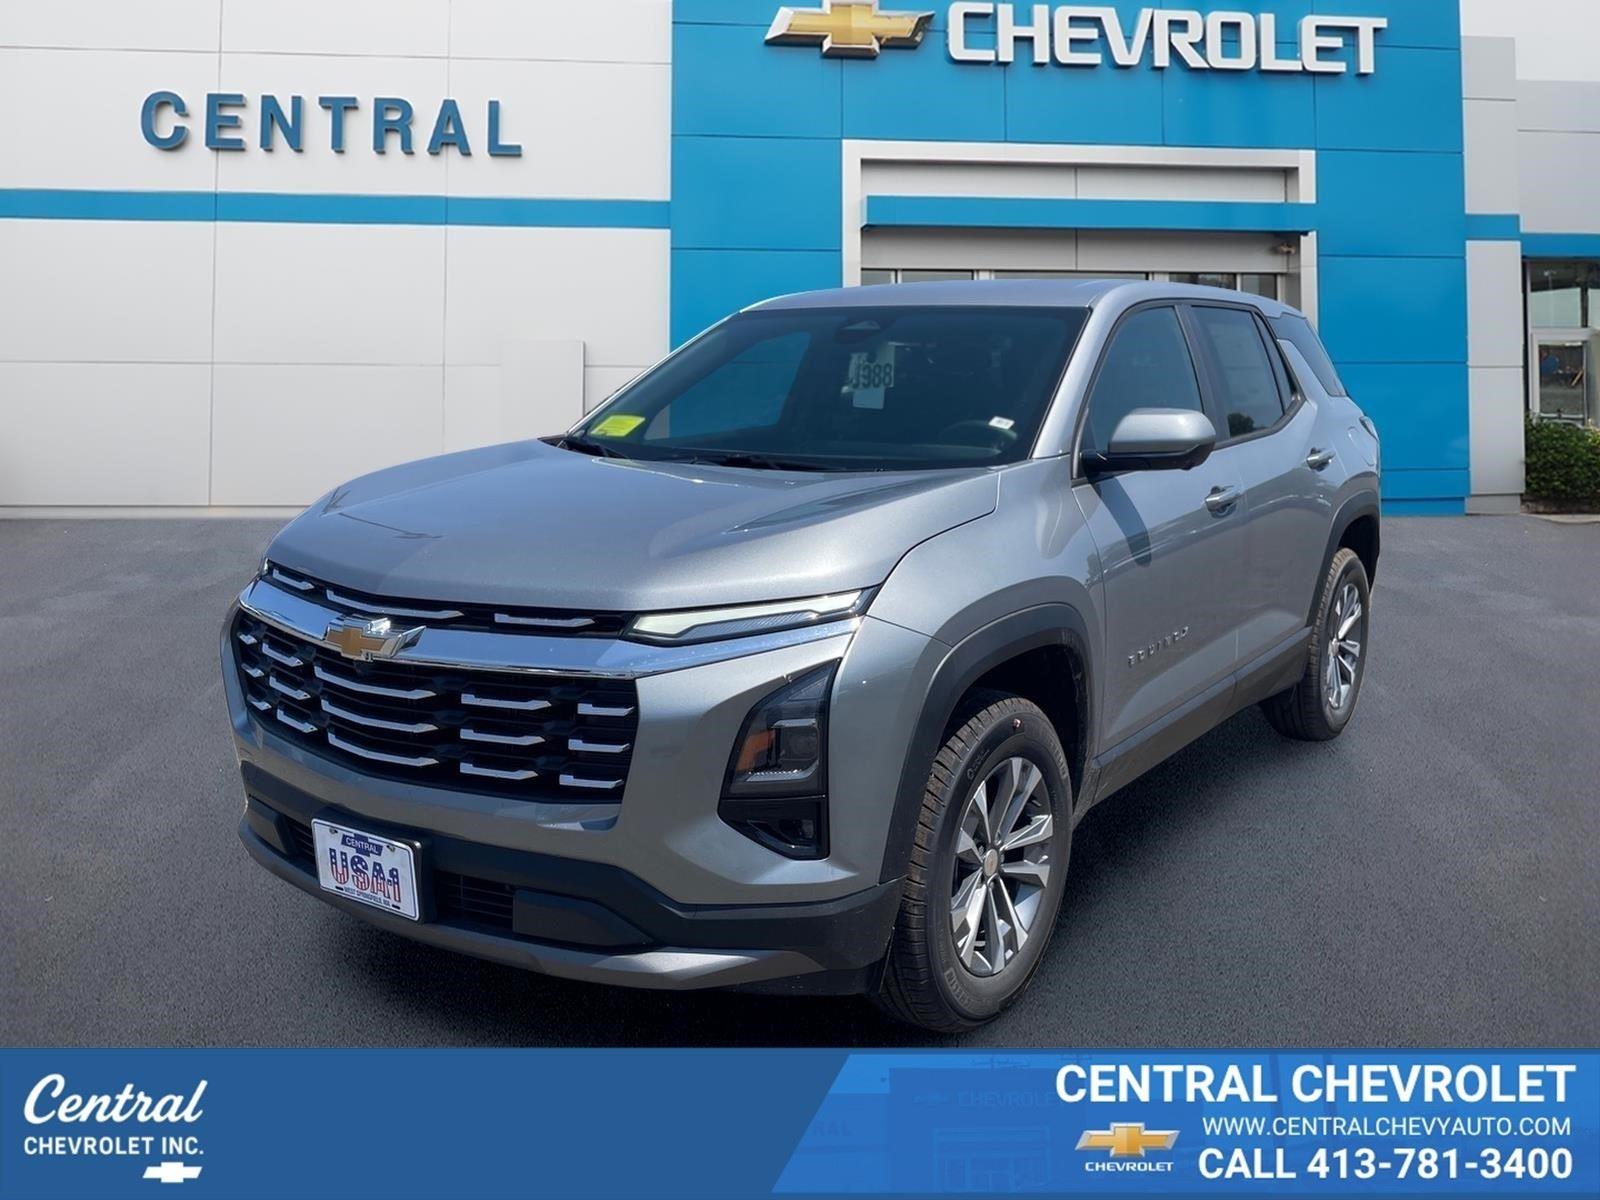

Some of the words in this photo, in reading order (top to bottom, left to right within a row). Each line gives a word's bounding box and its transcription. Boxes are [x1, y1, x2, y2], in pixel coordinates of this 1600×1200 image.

[947, 1, 1388, 75] CHEVROLET
[140, 90, 523, 157] CENTRAL
[345, 836, 380, 854] CENTRAL
